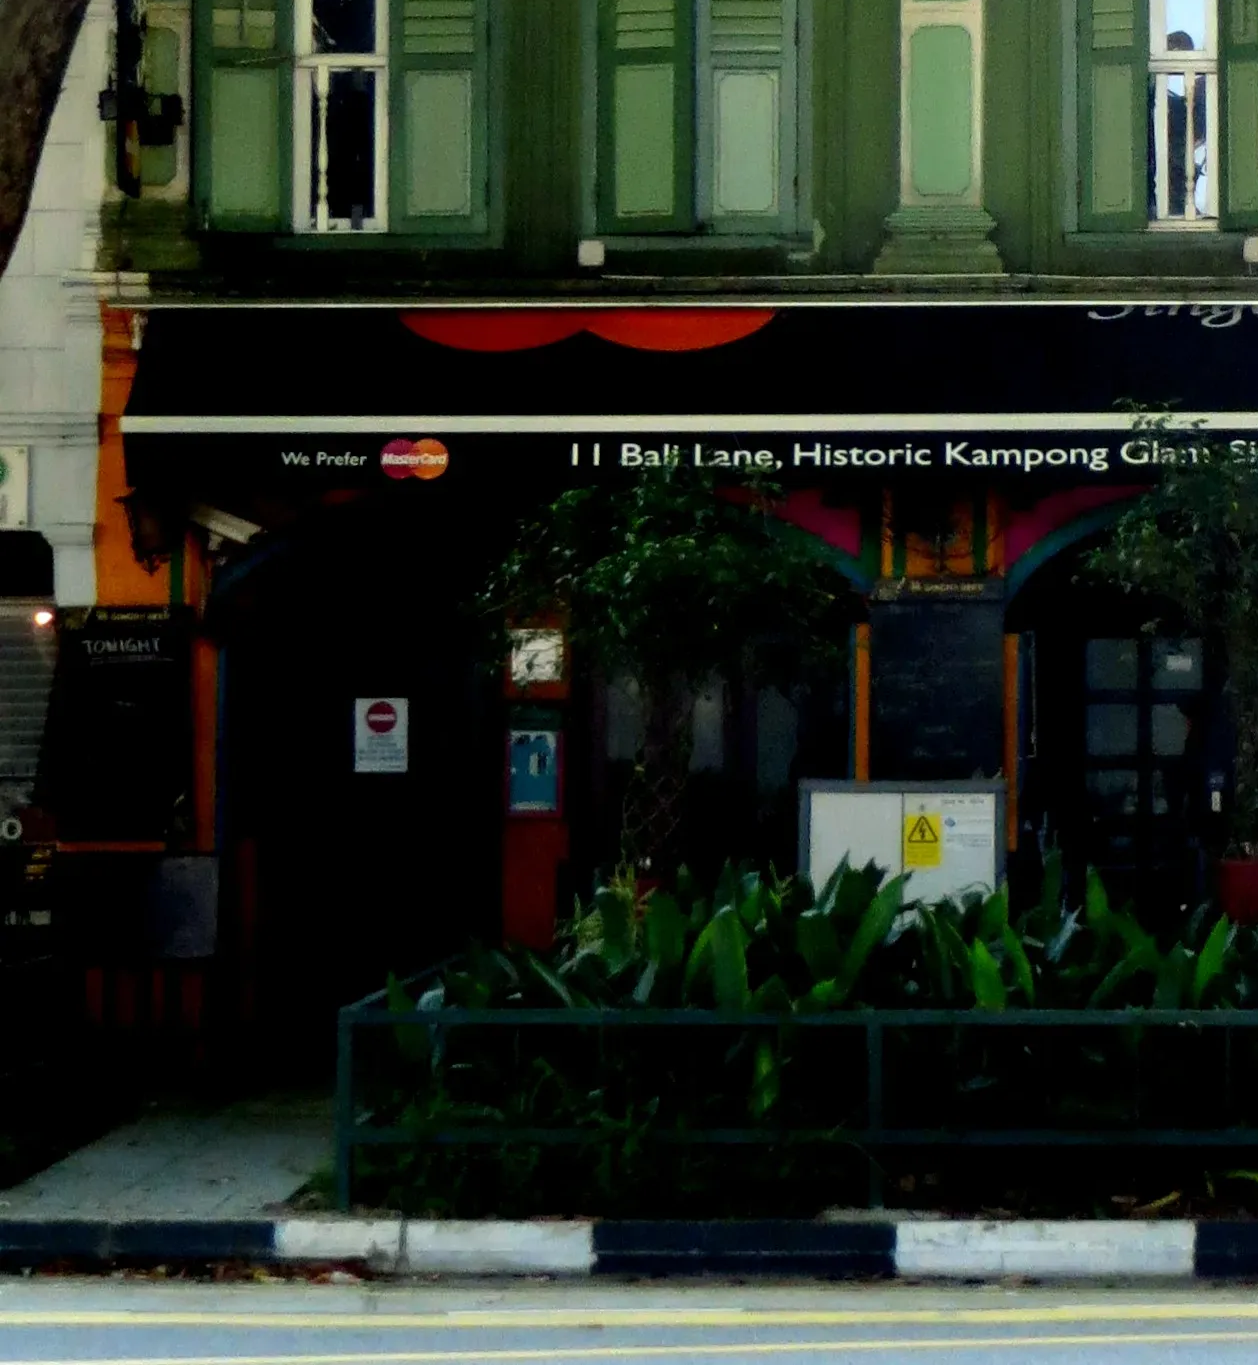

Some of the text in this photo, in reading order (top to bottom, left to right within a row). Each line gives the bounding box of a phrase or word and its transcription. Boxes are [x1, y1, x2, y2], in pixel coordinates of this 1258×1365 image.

[281, 451, 448, 466] We Prefer MasterCard
[620, 442, 680, 467] Bali
[694, 443, 783, 470] Lane,
[793, 442, 932, 467] Historic
[945, 442, 1109, 472] Kampong
[81, 637, 161, 655] TONIGHT
